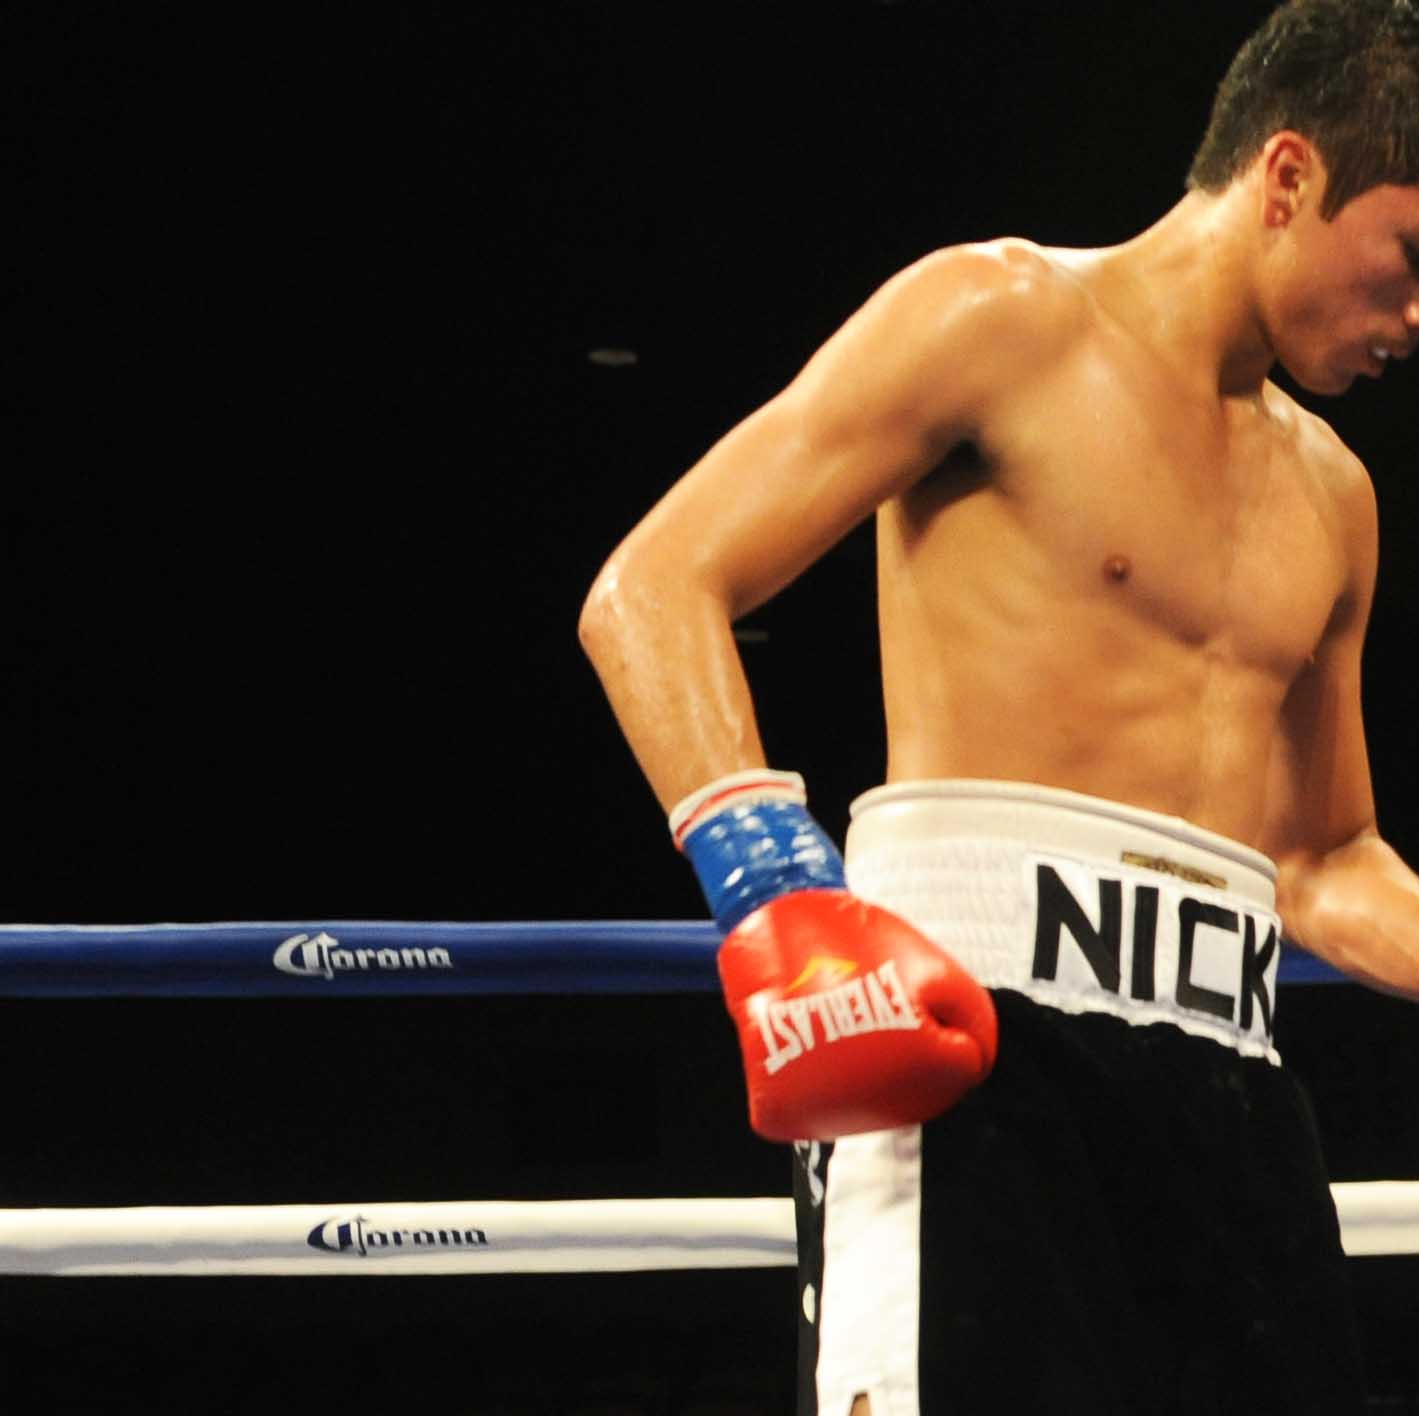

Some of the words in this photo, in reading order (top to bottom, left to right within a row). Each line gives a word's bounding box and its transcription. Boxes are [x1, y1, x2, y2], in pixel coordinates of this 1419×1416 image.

[272, 931, 454, 981] Corona
[1032, 863, 1281, 1038] NICK
[746, 961, 922, 1074] EVERLAST
[307, 1215, 489, 1257] Corona
